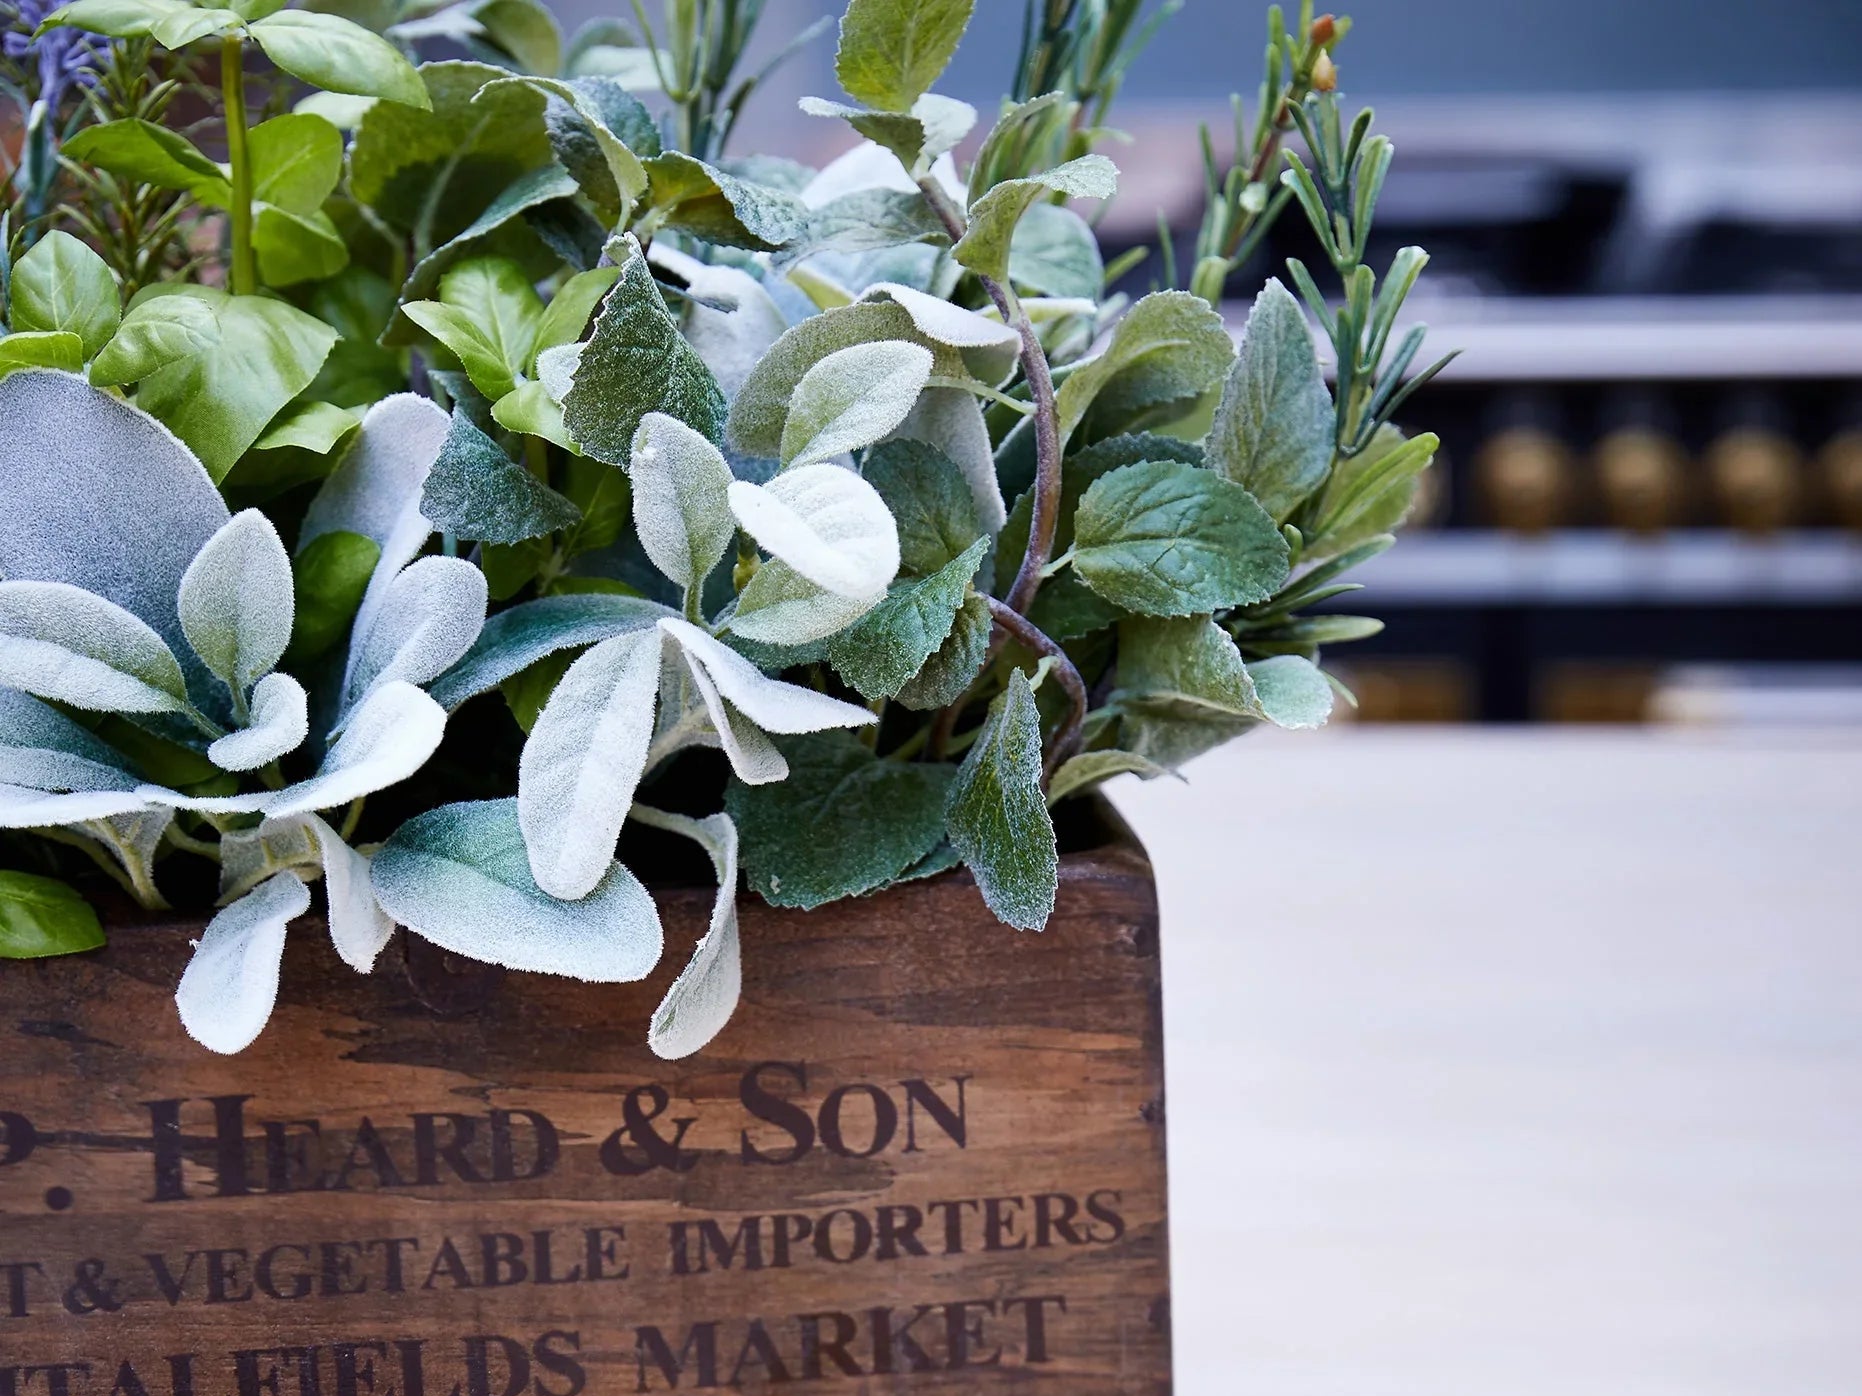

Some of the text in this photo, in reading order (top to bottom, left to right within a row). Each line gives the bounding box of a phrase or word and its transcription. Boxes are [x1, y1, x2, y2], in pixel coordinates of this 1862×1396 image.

[140, 1094, 560, 1201] HEARD
[599, 1083, 699, 1176] &
[740, 1060, 973, 1168] SON
[0, 1189, 1127, 1317] T & VEGETABLE IMPORTERS
[635, 1293, 1068, 1393] MARKET
